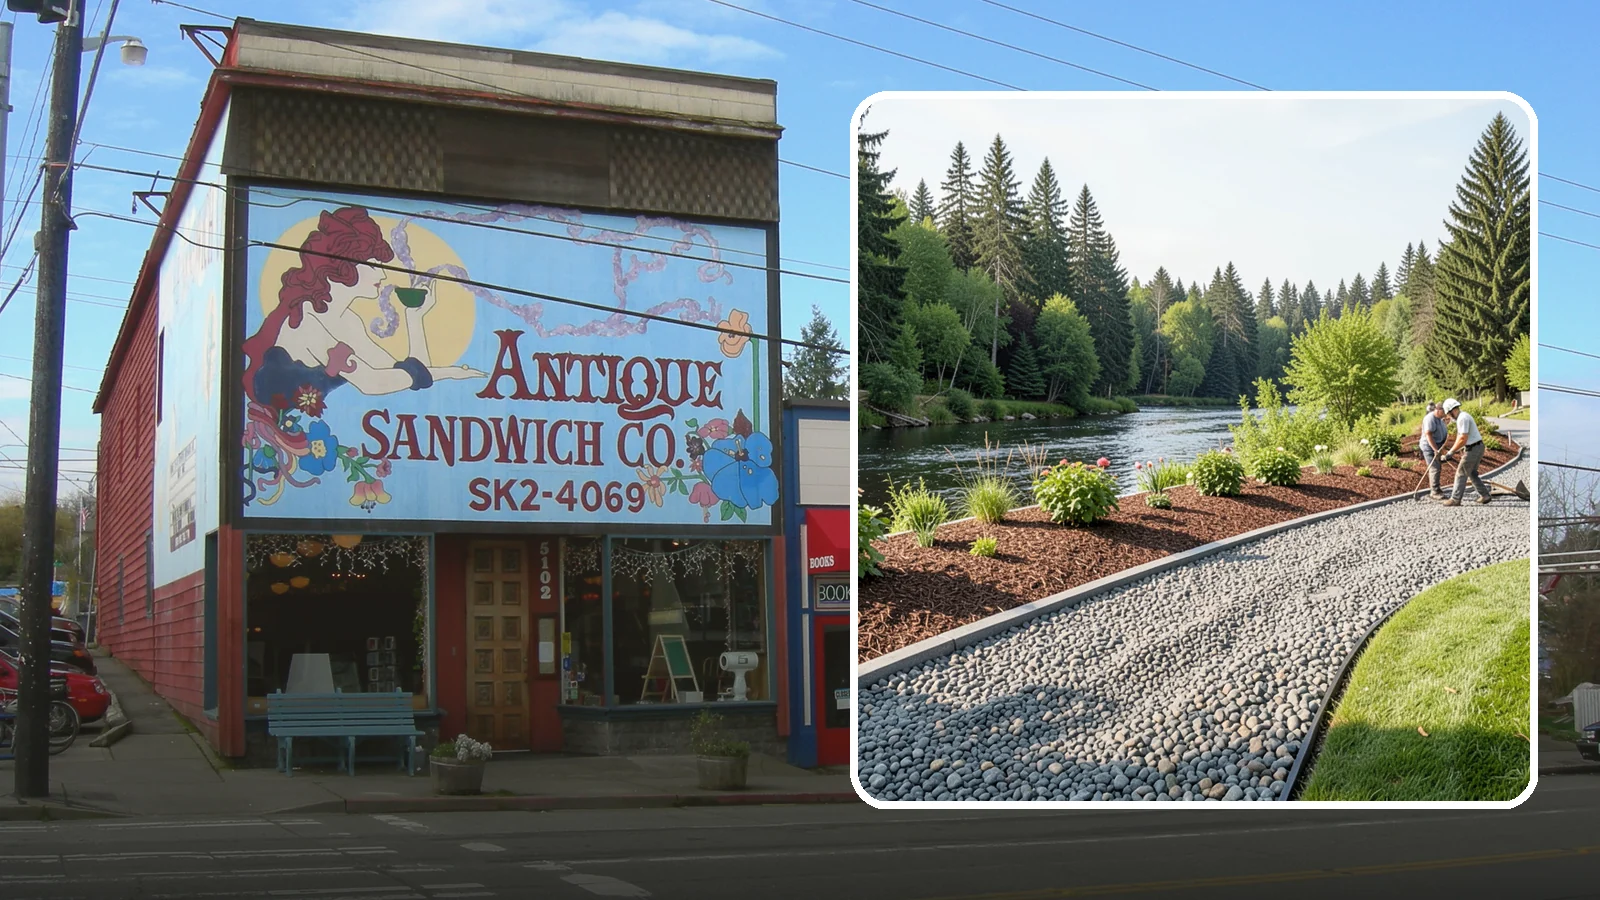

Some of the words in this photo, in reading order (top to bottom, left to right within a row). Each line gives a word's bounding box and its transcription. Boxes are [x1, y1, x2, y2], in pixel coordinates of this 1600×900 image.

[475, 328, 724, 421] ANTIQUE
[361, 408, 605, 467] SANDWICH
[616, 422, 685, 469] CO.
[468, 477, 646, 512] SK2-4069
[539, 541, 551, 600] 5102
[809, 555, 835, 569] BOOKS
